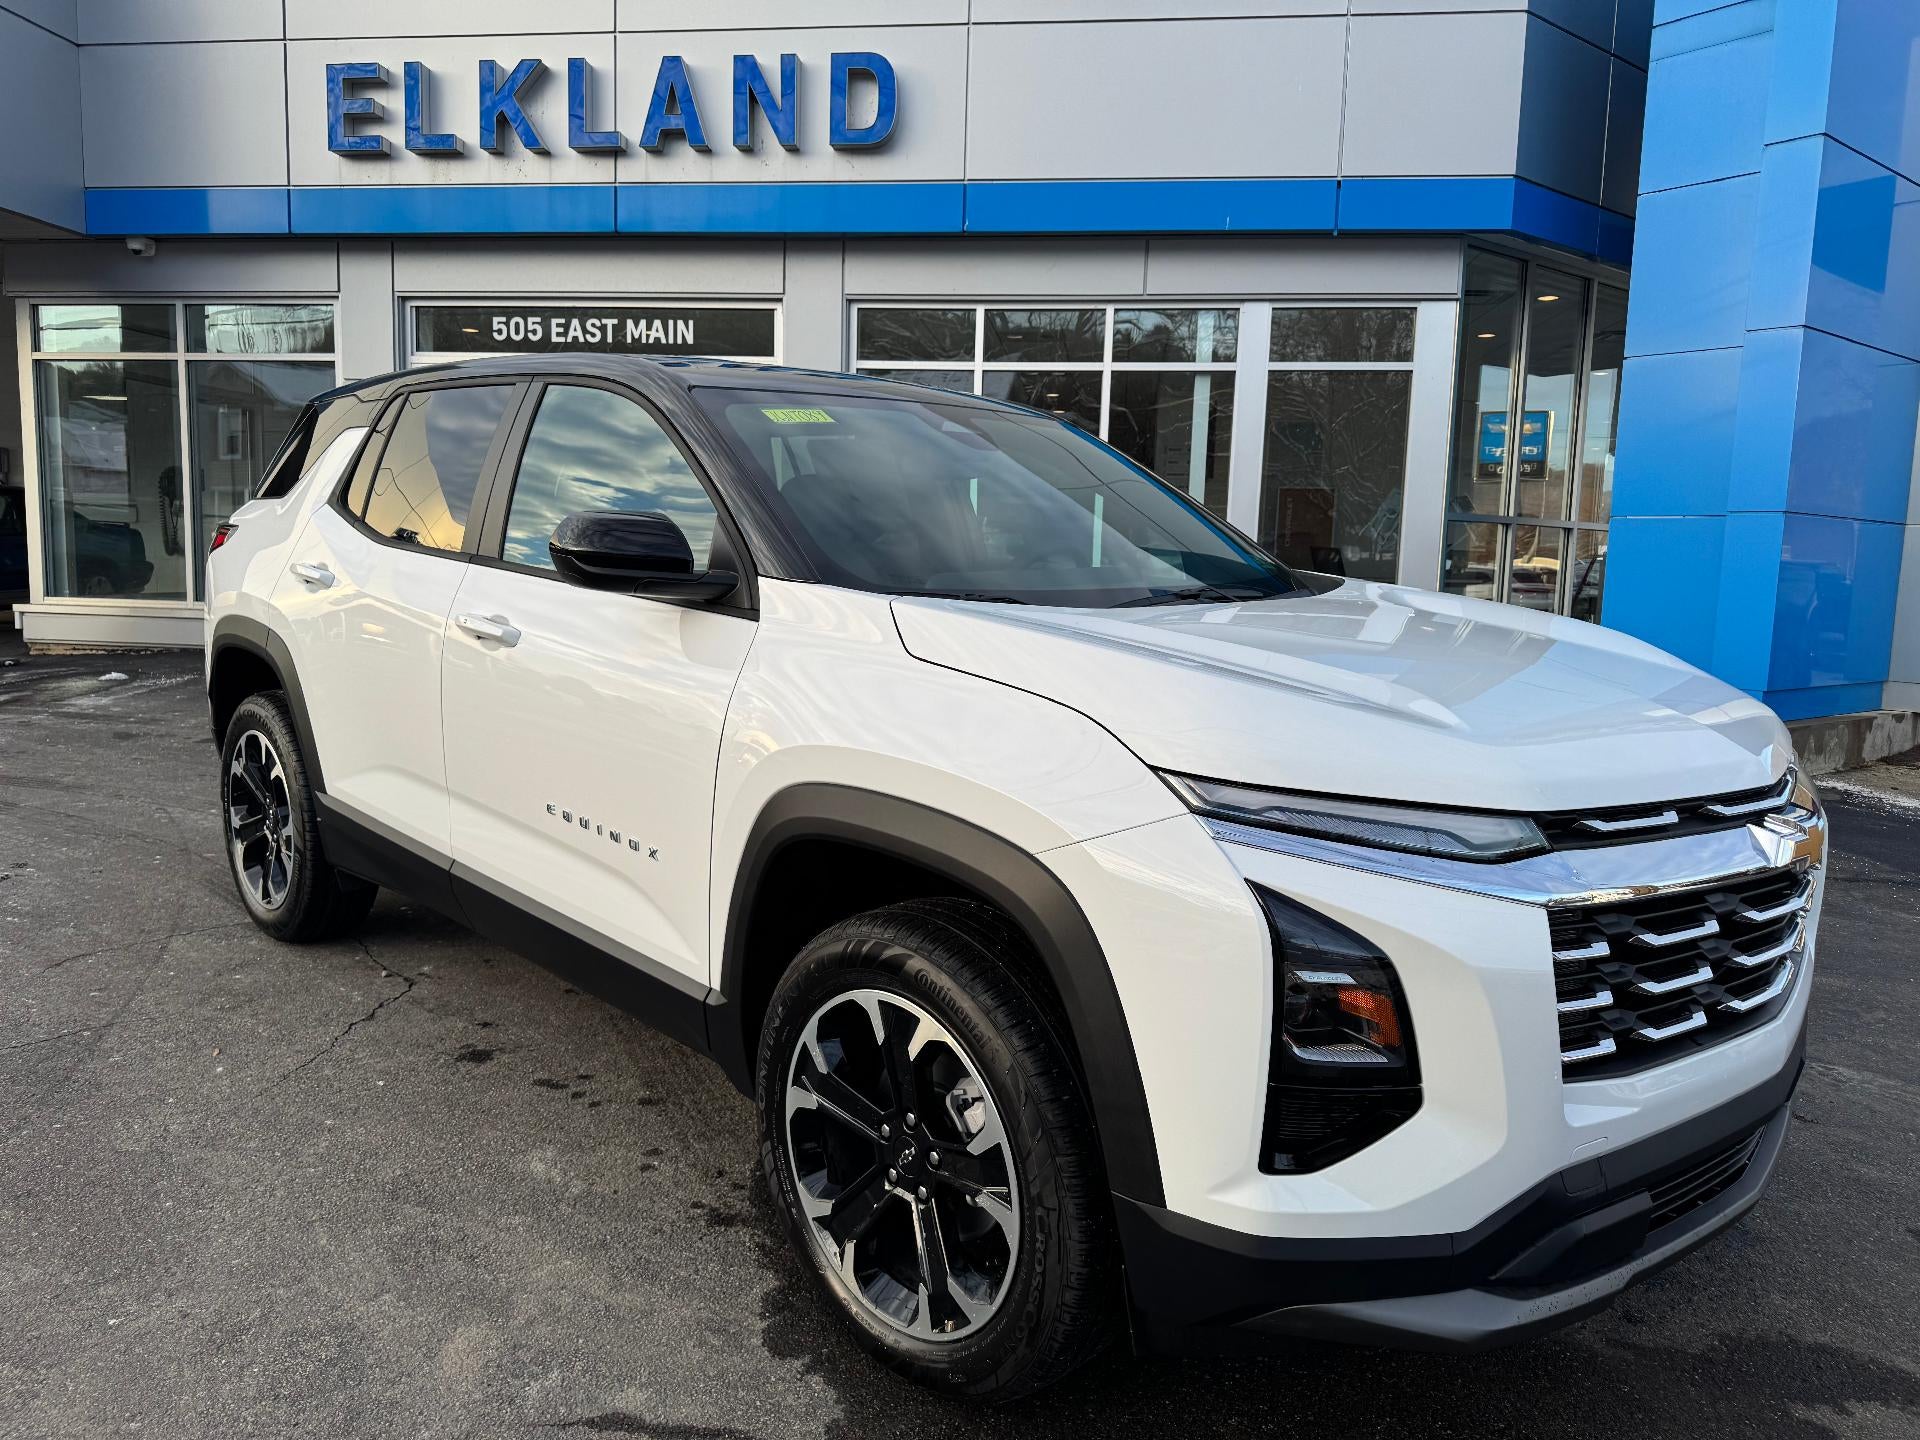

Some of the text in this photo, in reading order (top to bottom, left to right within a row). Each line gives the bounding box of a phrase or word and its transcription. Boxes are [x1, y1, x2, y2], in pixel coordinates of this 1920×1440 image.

[326, 52, 897, 156] ELKLAND
[492, 316, 694, 344] 505 EAST MAIN
[546, 803, 659, 861] EQUINOX
[914, 968, 992, 1049] Continental
